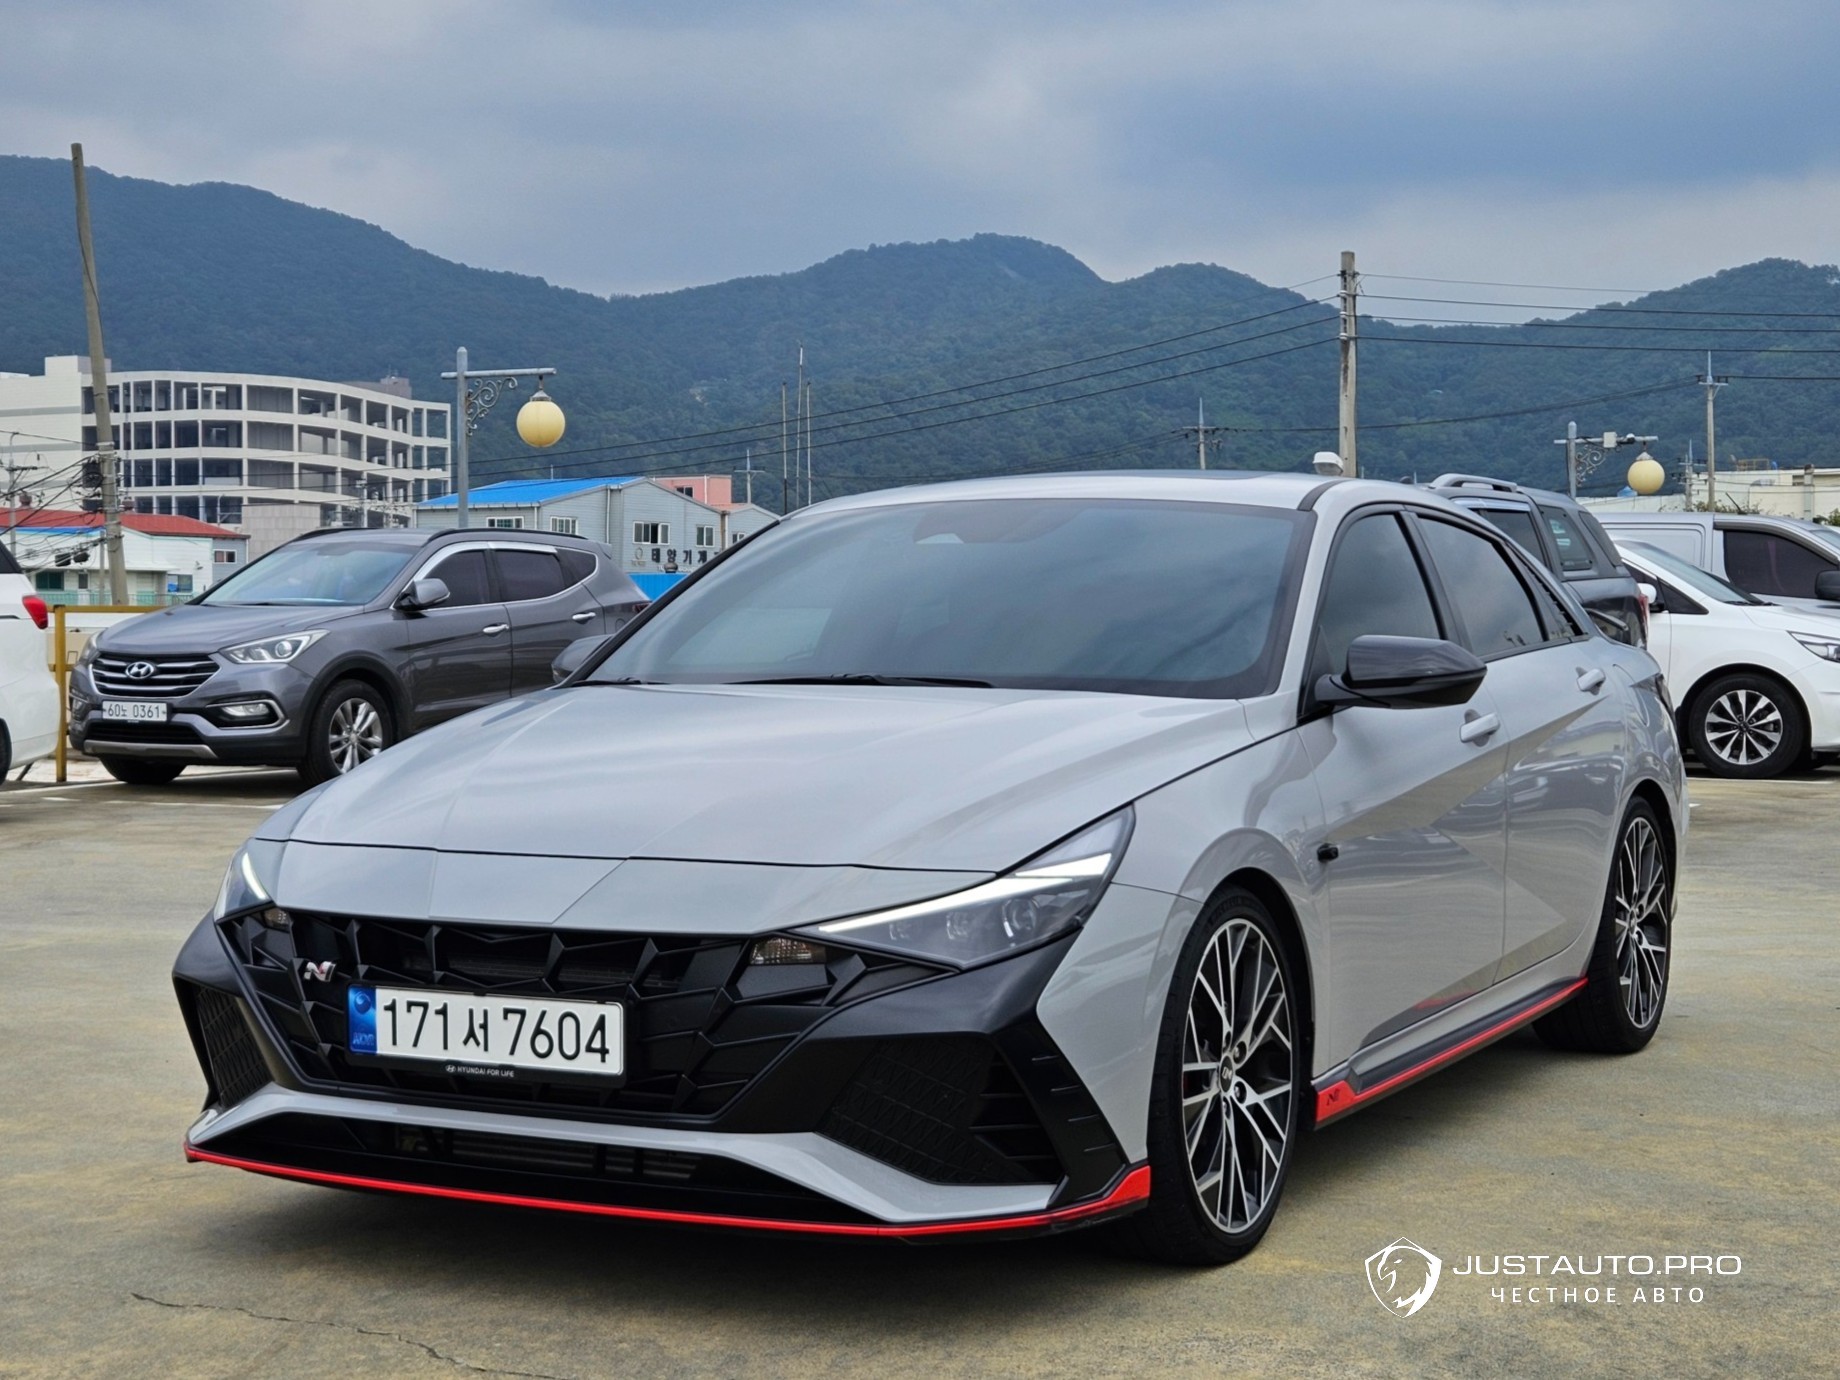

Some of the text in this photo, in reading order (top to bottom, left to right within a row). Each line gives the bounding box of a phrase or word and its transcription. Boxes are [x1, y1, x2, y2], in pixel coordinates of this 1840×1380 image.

[651, 547, 720, 565] 태양기계
[132, 704, 160, 718] 0361
[457, 1066, 515, 1078] HYUNDAI FOR LIFE
